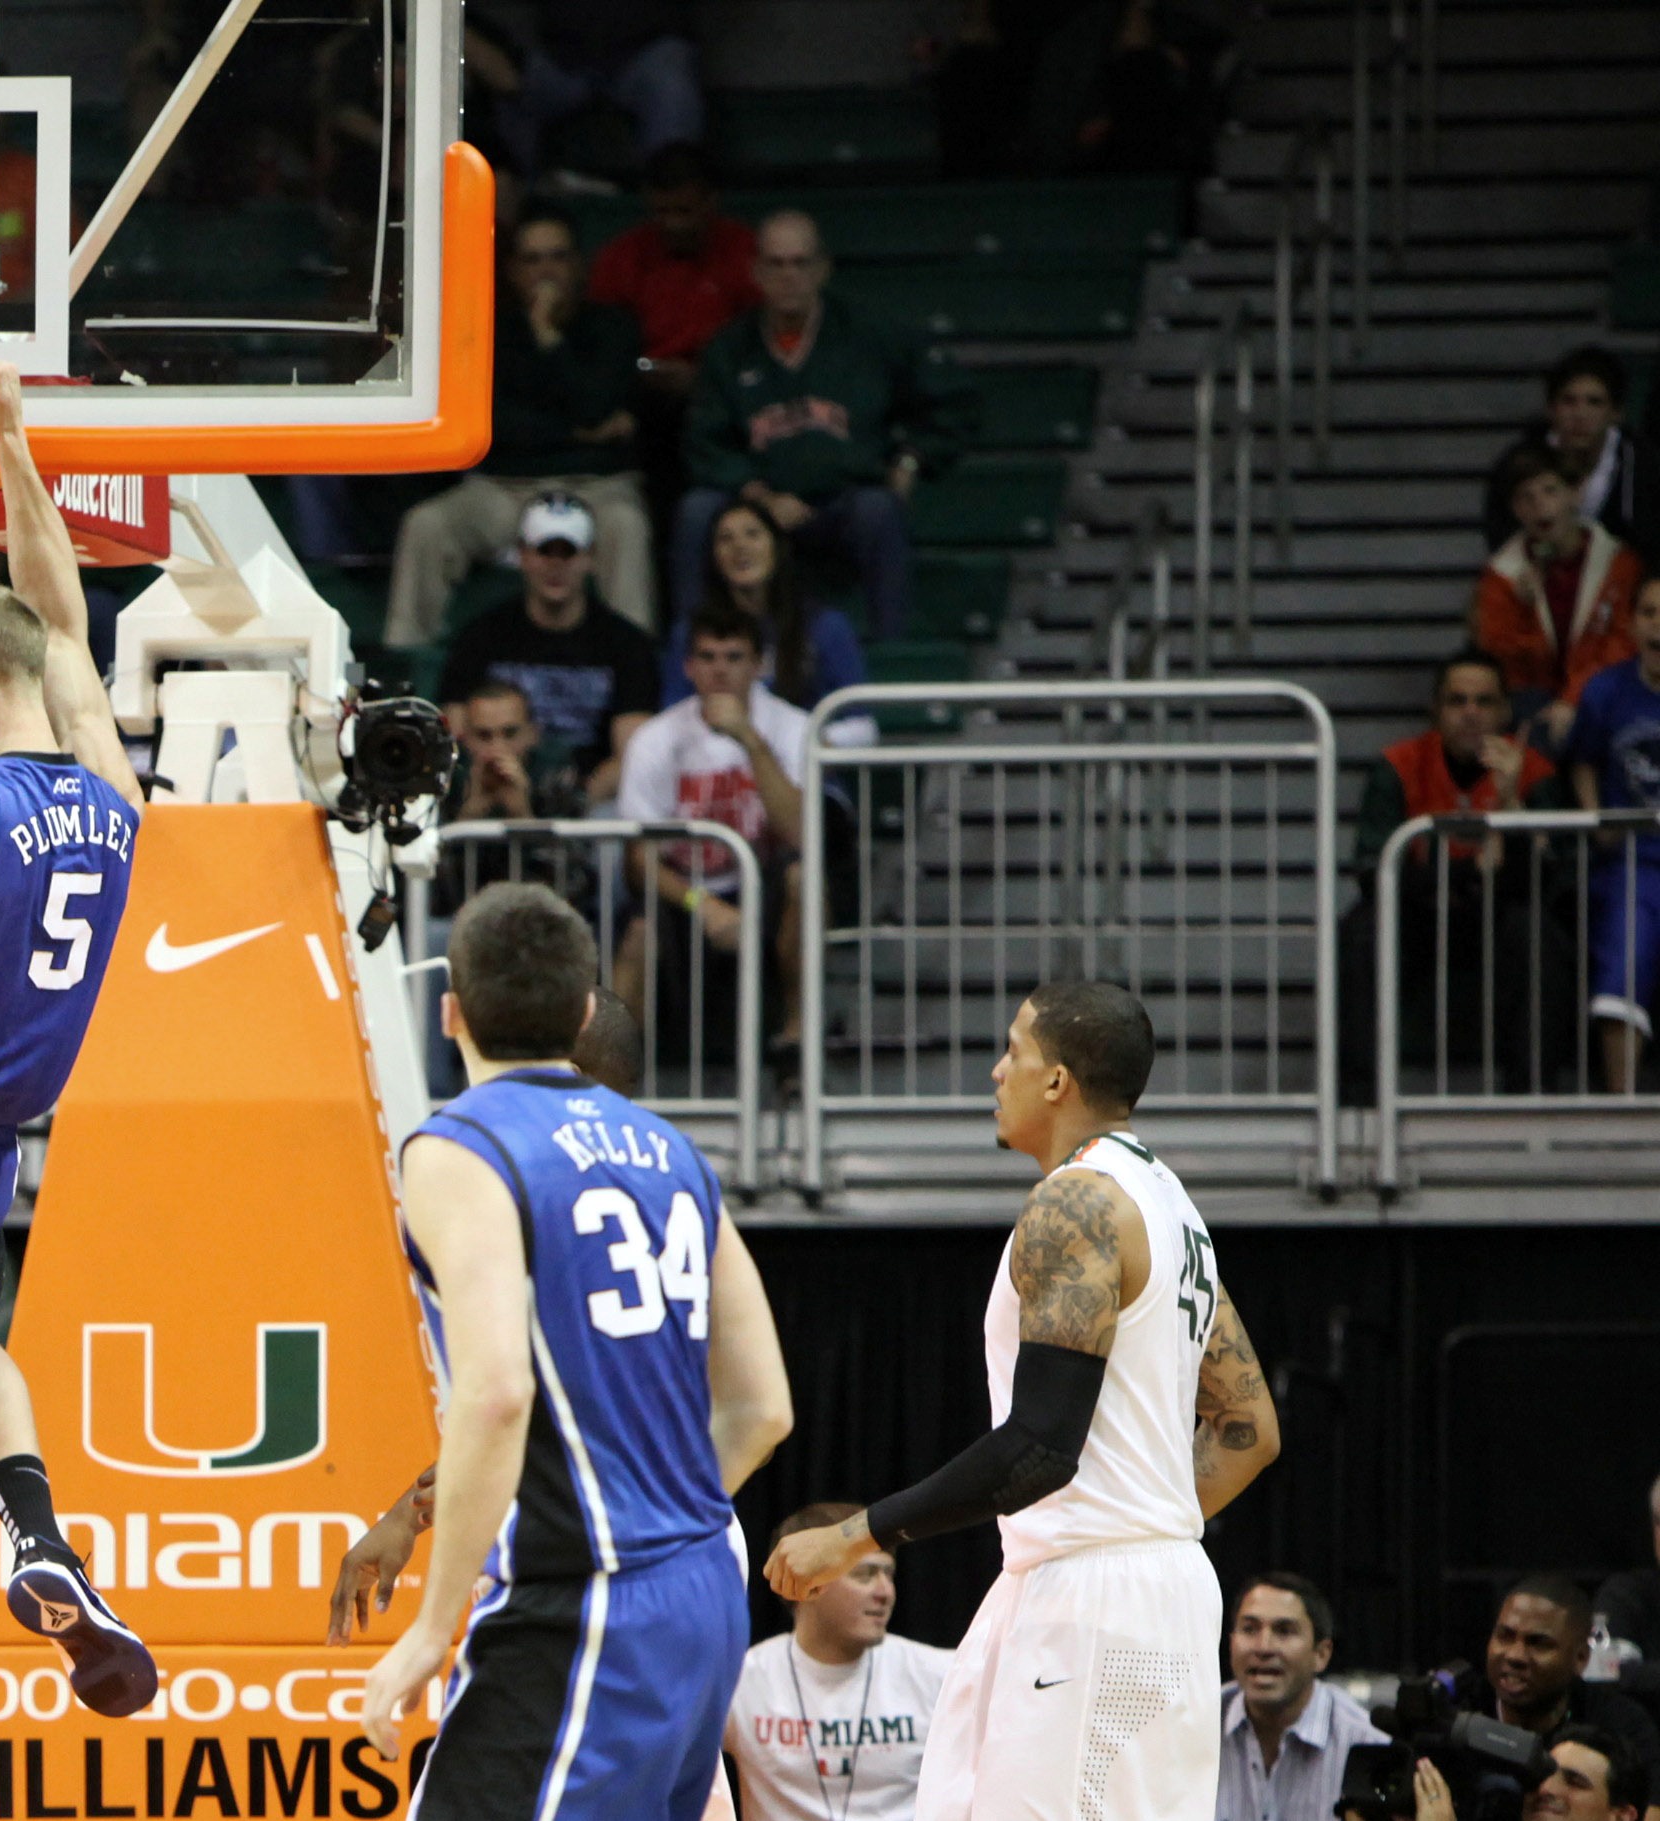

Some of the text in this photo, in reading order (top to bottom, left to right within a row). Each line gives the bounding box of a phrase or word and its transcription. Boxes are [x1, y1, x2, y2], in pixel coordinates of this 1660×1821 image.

[53, 777, 81, 795] ACC
[10, 804, 132, 866] PLUMLEE
[28, 872, 103, 991] 5
[551, 1120, 670, 1173] KELLY
[572, 1187, 710, 1341] 34
[1177, 1222, 1214, 1348] 45
[82, 1322, 328, 1478] U
[819, 1715, 918, 1747] MIAMI
